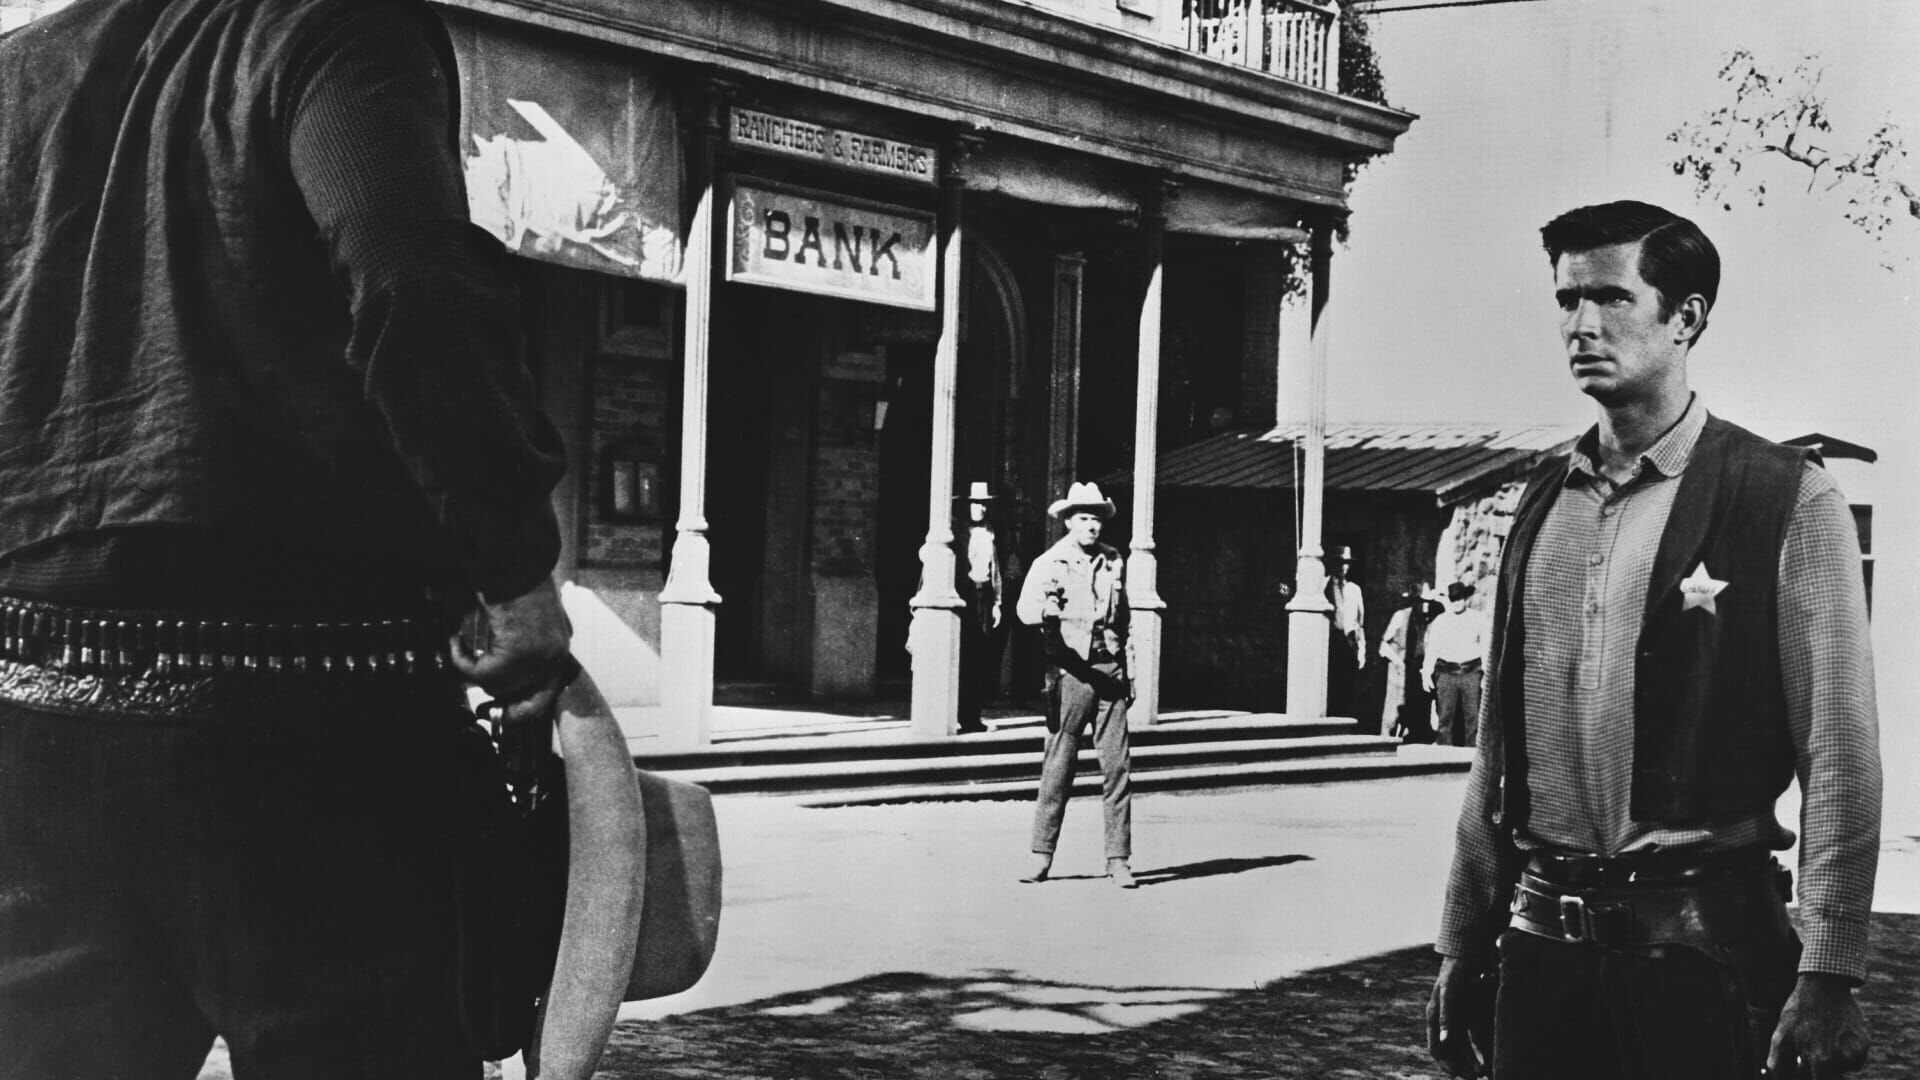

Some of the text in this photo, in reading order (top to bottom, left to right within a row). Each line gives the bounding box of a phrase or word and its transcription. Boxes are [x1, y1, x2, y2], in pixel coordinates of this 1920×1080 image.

[737, 112, 928, 175] RANCHERS & FARMERS
[763, 208, 901, 280] BANK
